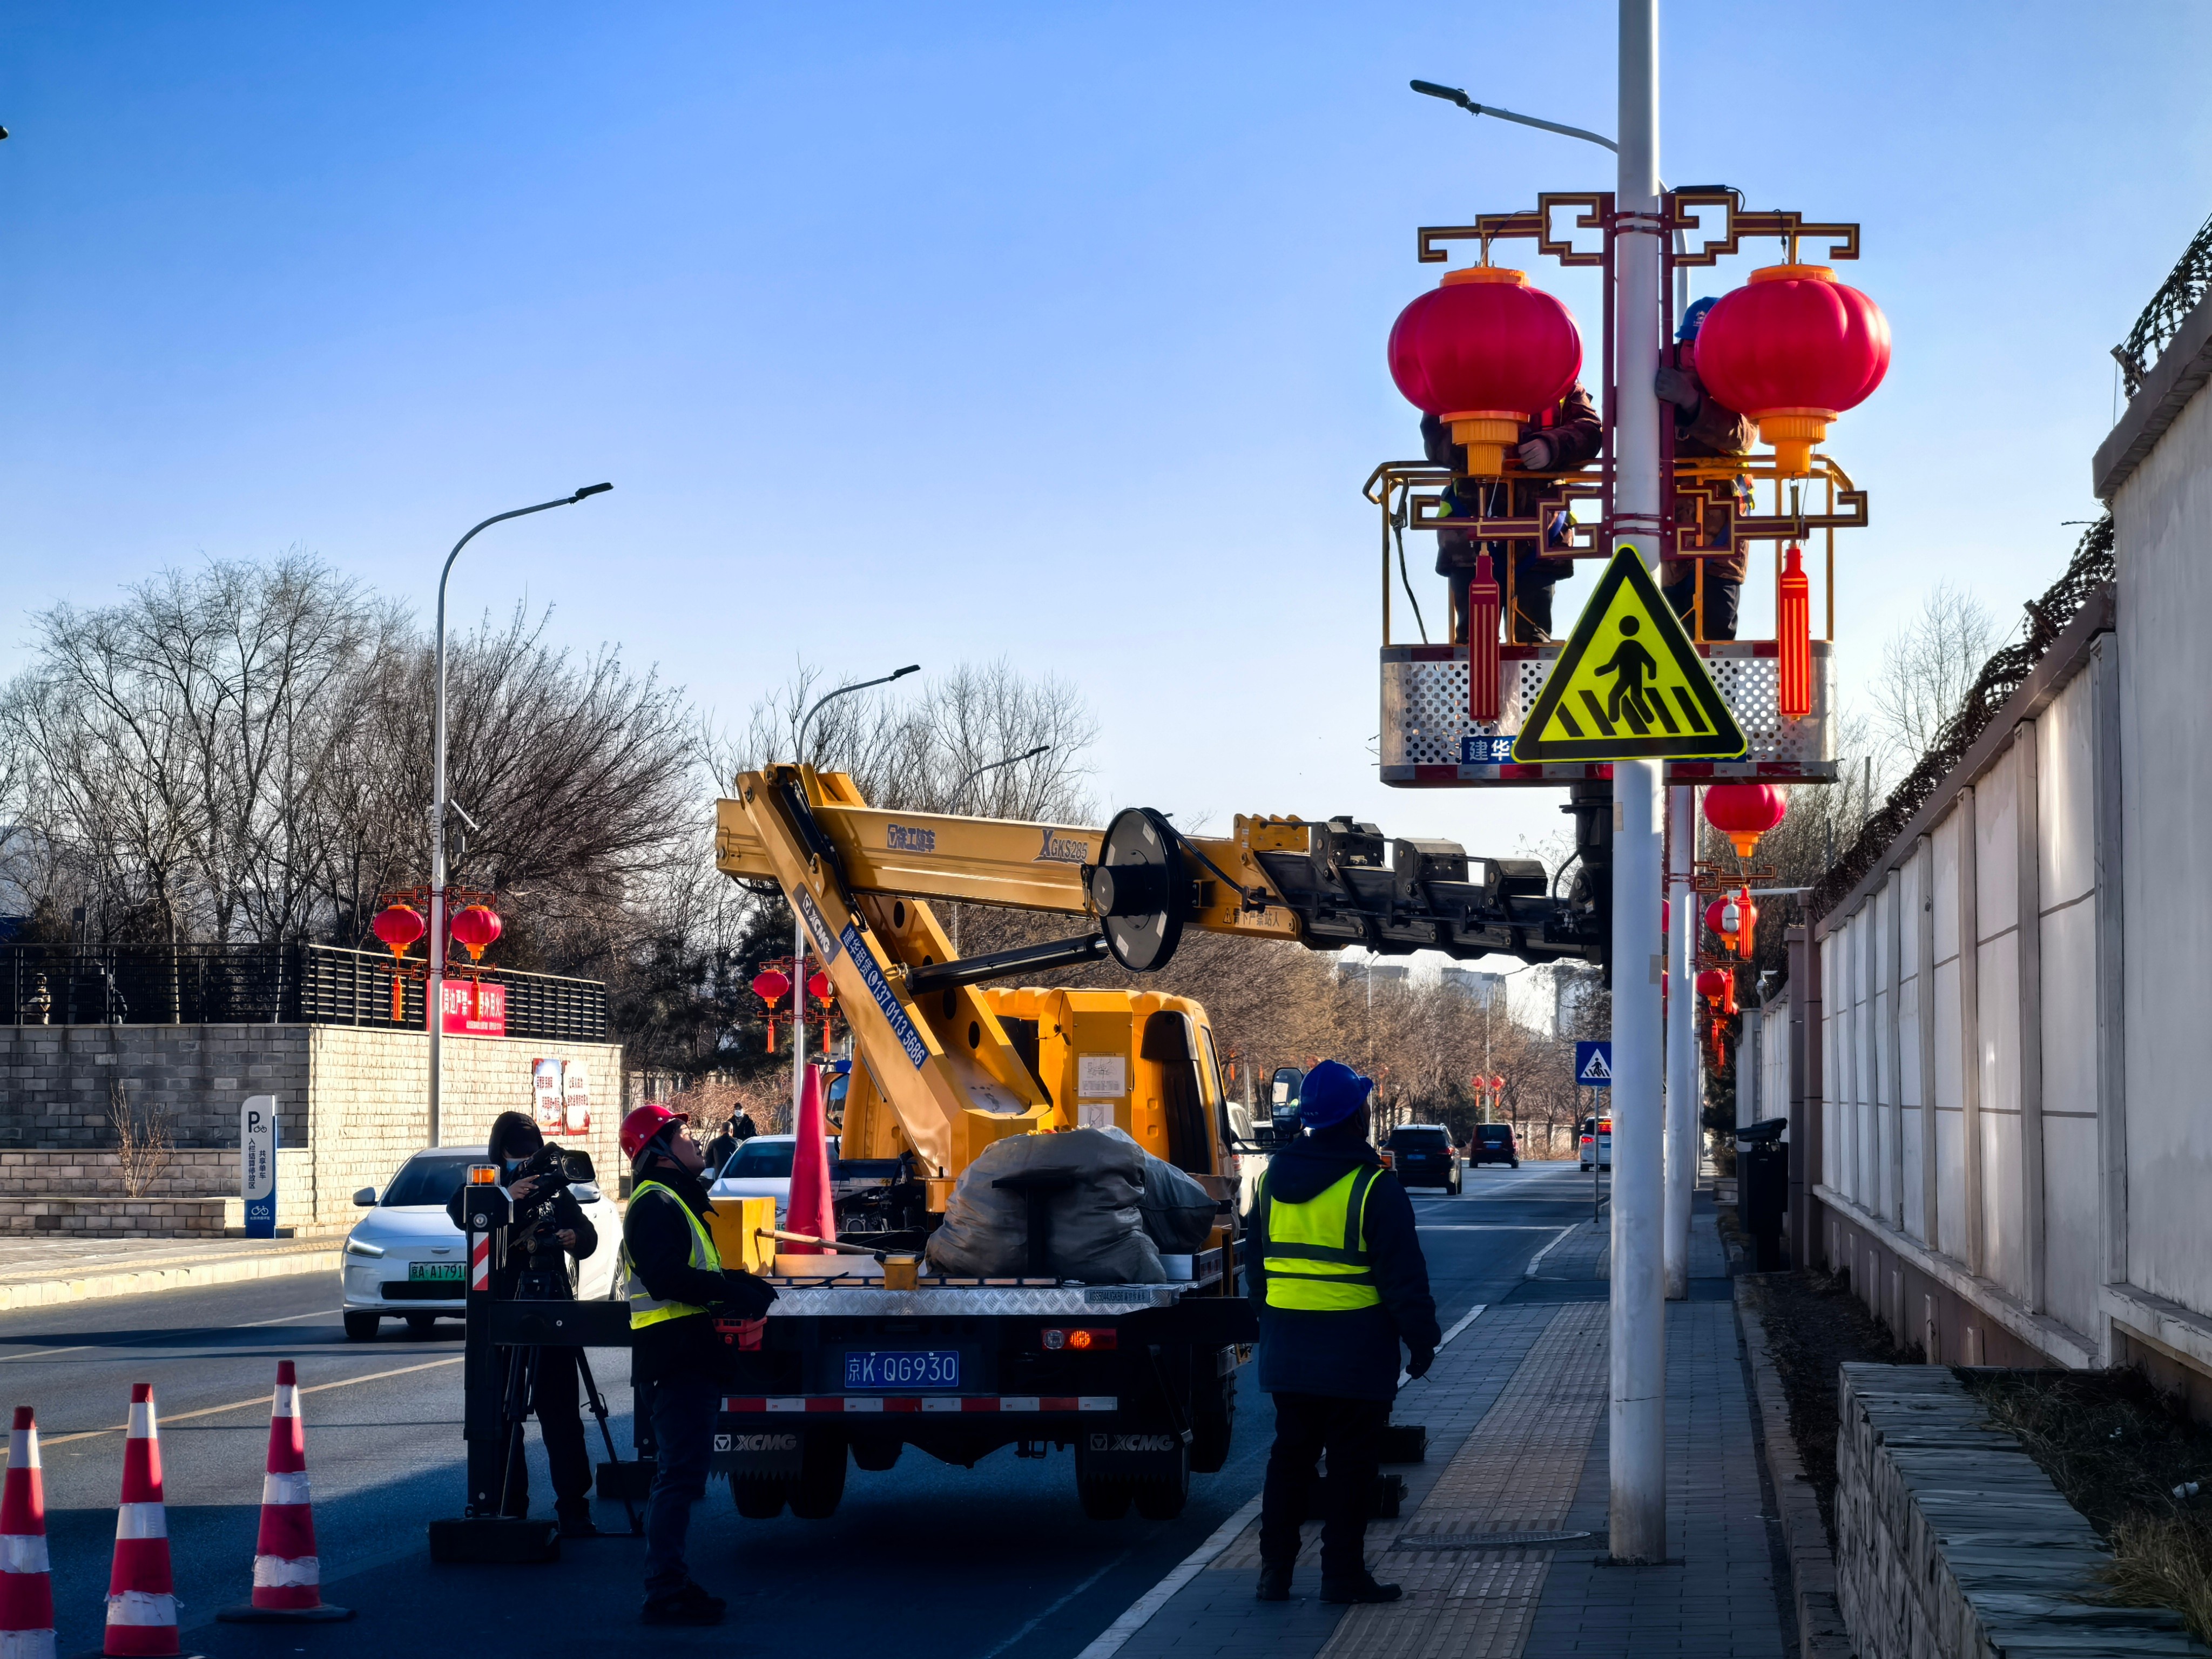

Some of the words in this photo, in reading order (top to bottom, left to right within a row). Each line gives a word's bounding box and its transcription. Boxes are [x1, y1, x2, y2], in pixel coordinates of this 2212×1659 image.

[1469, 740, 1515, 761] 建华
[896, 827, 935, 853] 徐工随车
[1040, 829, 1088, 860] XGKS285
[808, 909, 830, 953] XCMG
[842, 927, 874, 978] 建华租赁
[872, 981, 891, 1006] 137
[886, 1003, 906, 1036] 0113
[903, 1029, 925, 1065] 5686
[248, 1111, 260, 1133] P
[733, 1434, 797, 1451] XCMG
[1110, 1434, 1174, 1451] XCMG
